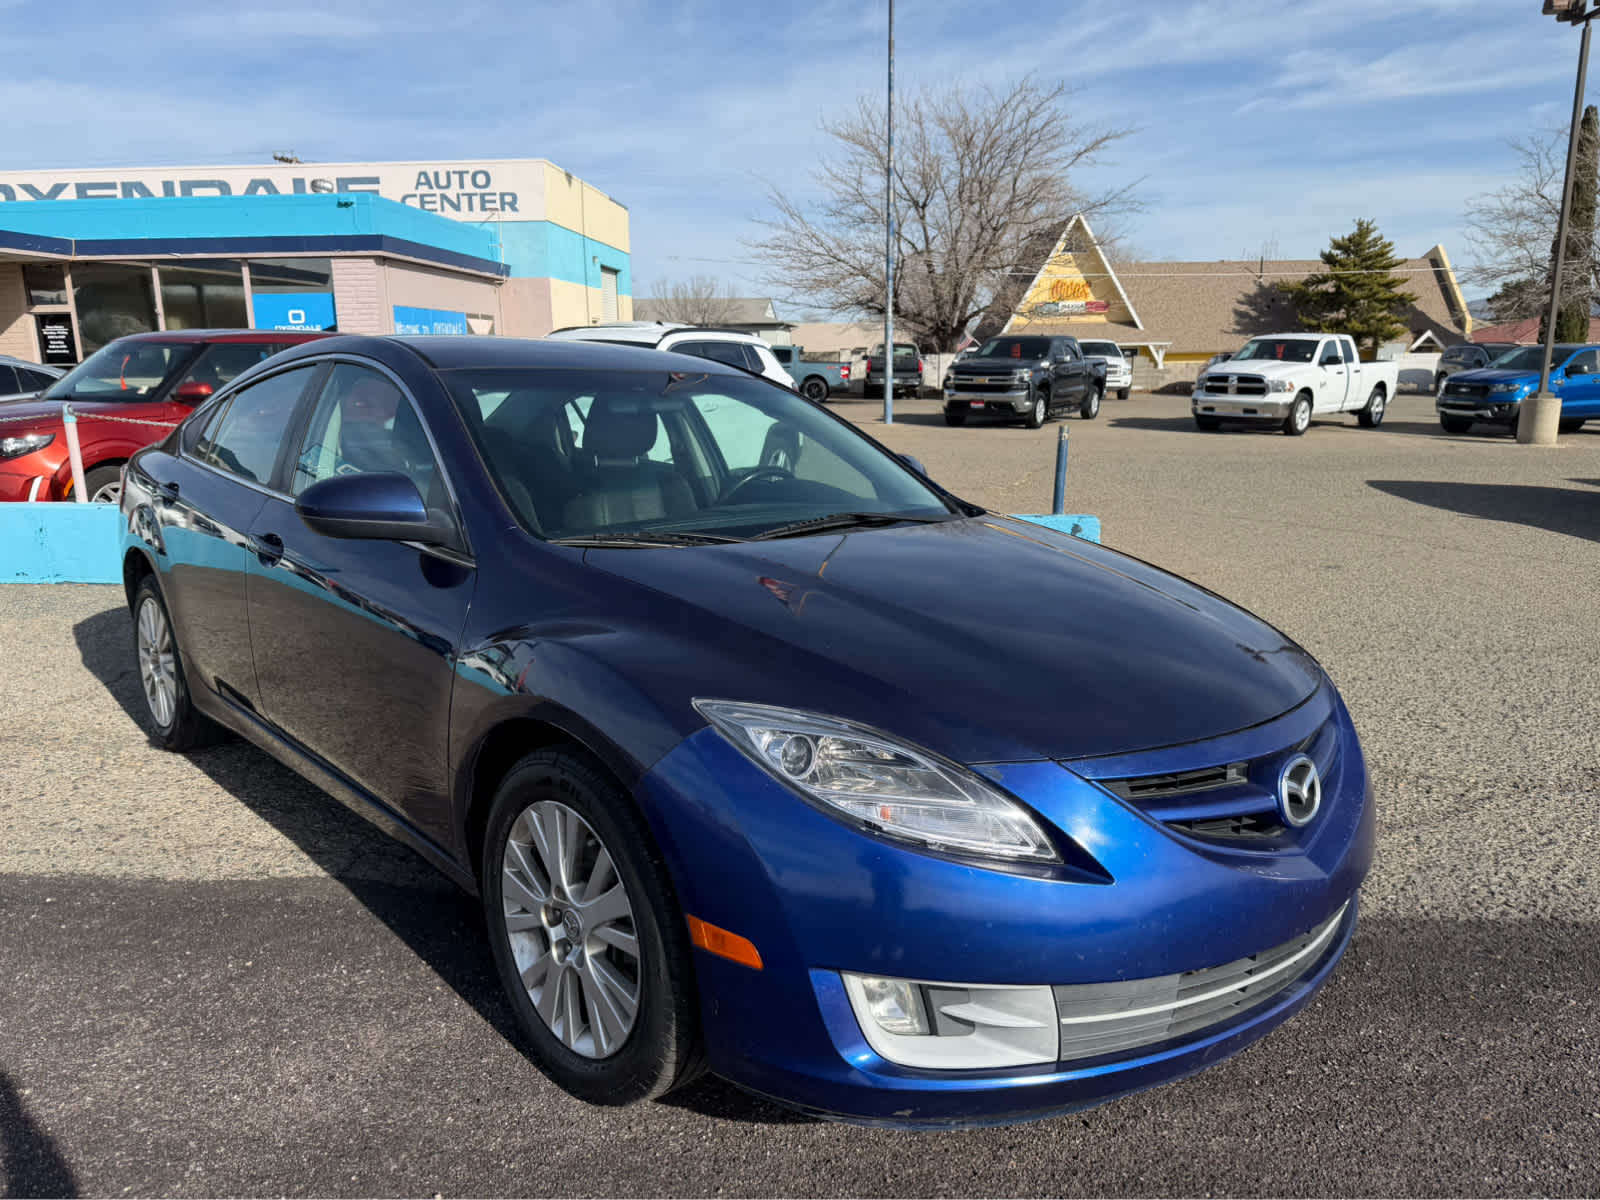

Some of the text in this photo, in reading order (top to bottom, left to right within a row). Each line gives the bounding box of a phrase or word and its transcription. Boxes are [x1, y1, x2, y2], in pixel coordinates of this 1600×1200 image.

[0, 176, 381, 201] XENDAE
[414, 169, 492, 190] AUTO
[400, 191, 520, 213] CENTER
